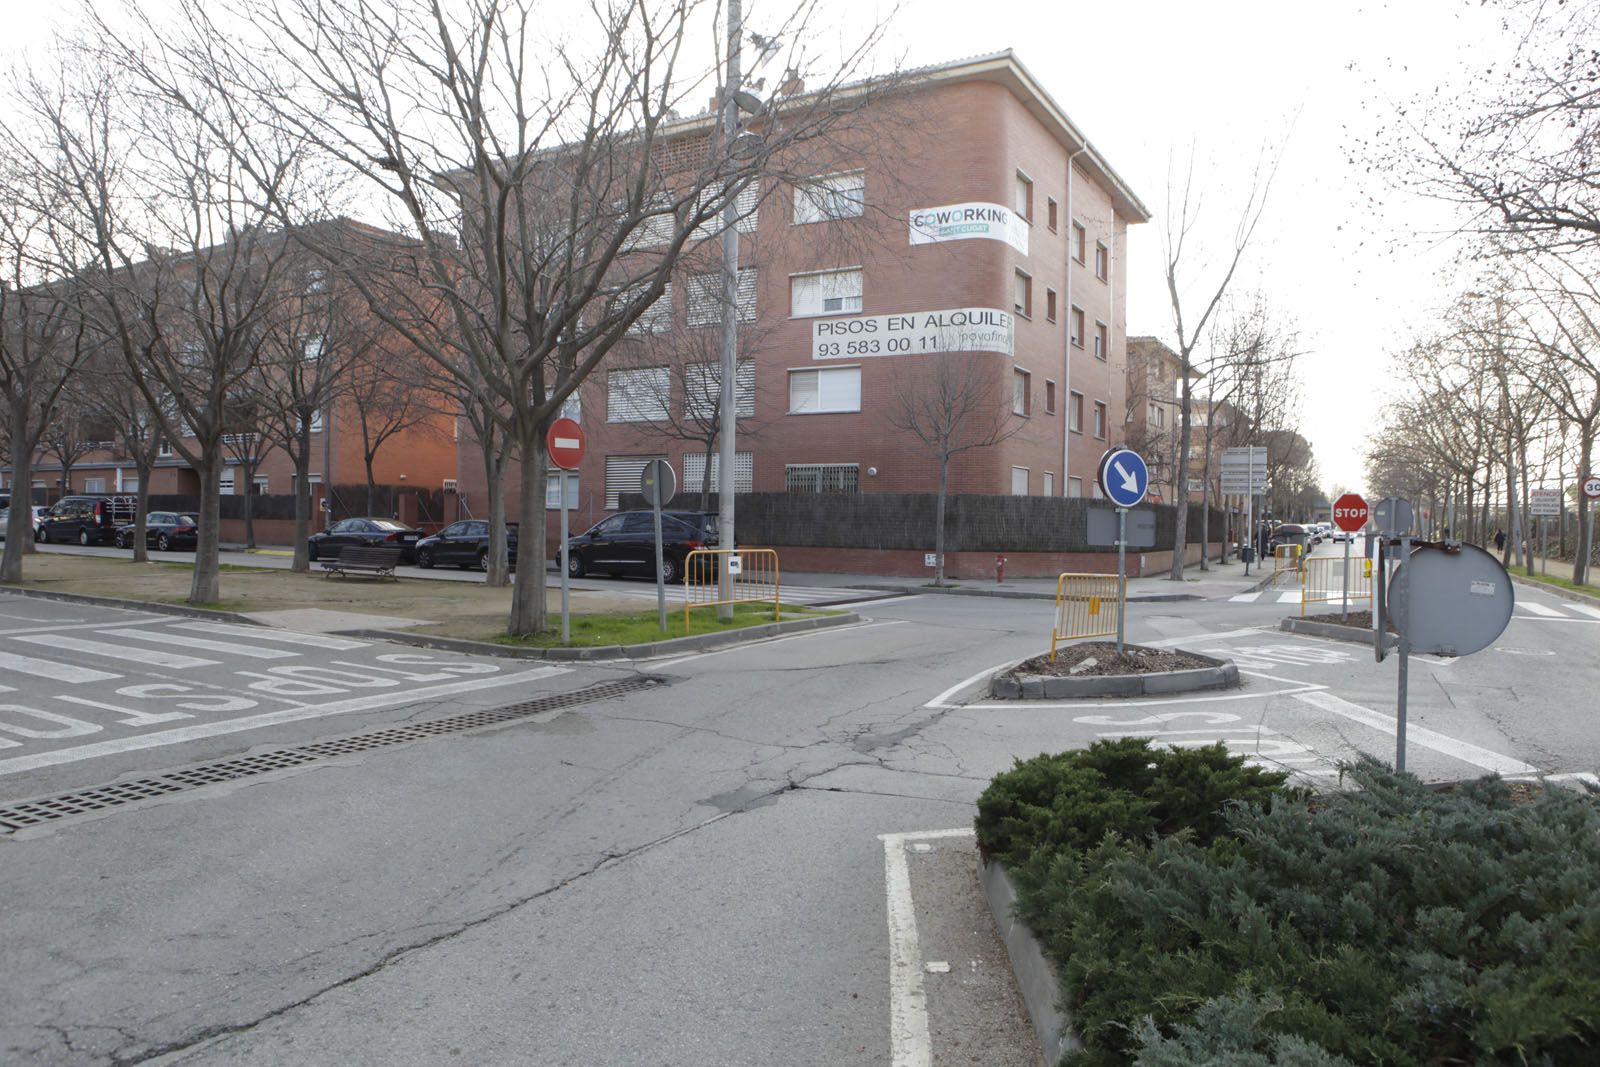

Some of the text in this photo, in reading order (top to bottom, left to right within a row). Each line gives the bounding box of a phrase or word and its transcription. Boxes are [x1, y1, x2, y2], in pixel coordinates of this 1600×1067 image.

[914, 208, 1008, 227] COWORKING
[818, 319, 878, 336] PISOS
[887, 316, 915, 331] EN
[818, 335, 937, 357] 93 583 00 11
[1335, 508, 1367, 518] STOP
[235, 653, 500, 696] STOP
[0, 684, 257, 750] STO
